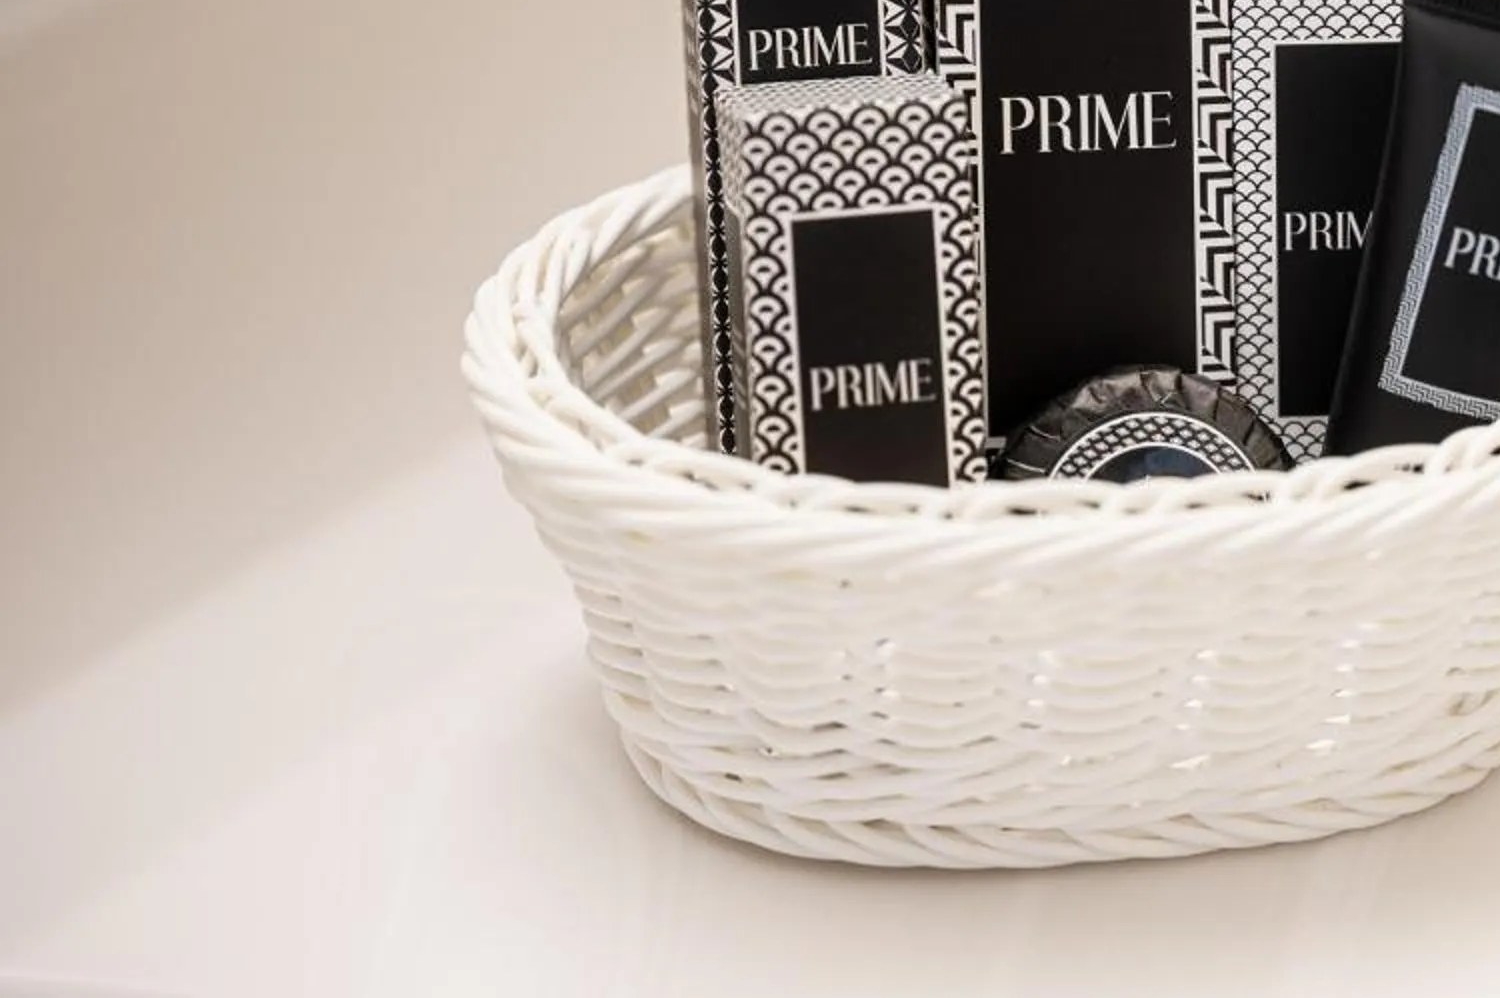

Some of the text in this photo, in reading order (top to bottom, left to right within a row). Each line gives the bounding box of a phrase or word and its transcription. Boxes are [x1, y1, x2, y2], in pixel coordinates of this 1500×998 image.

[747, 22, 873, 71] PRIME
[999, 90, 1177, 155] PRIME
[1284, 211, 1373, 251] PRIM
[809, 358, 935, 411] PRIME
